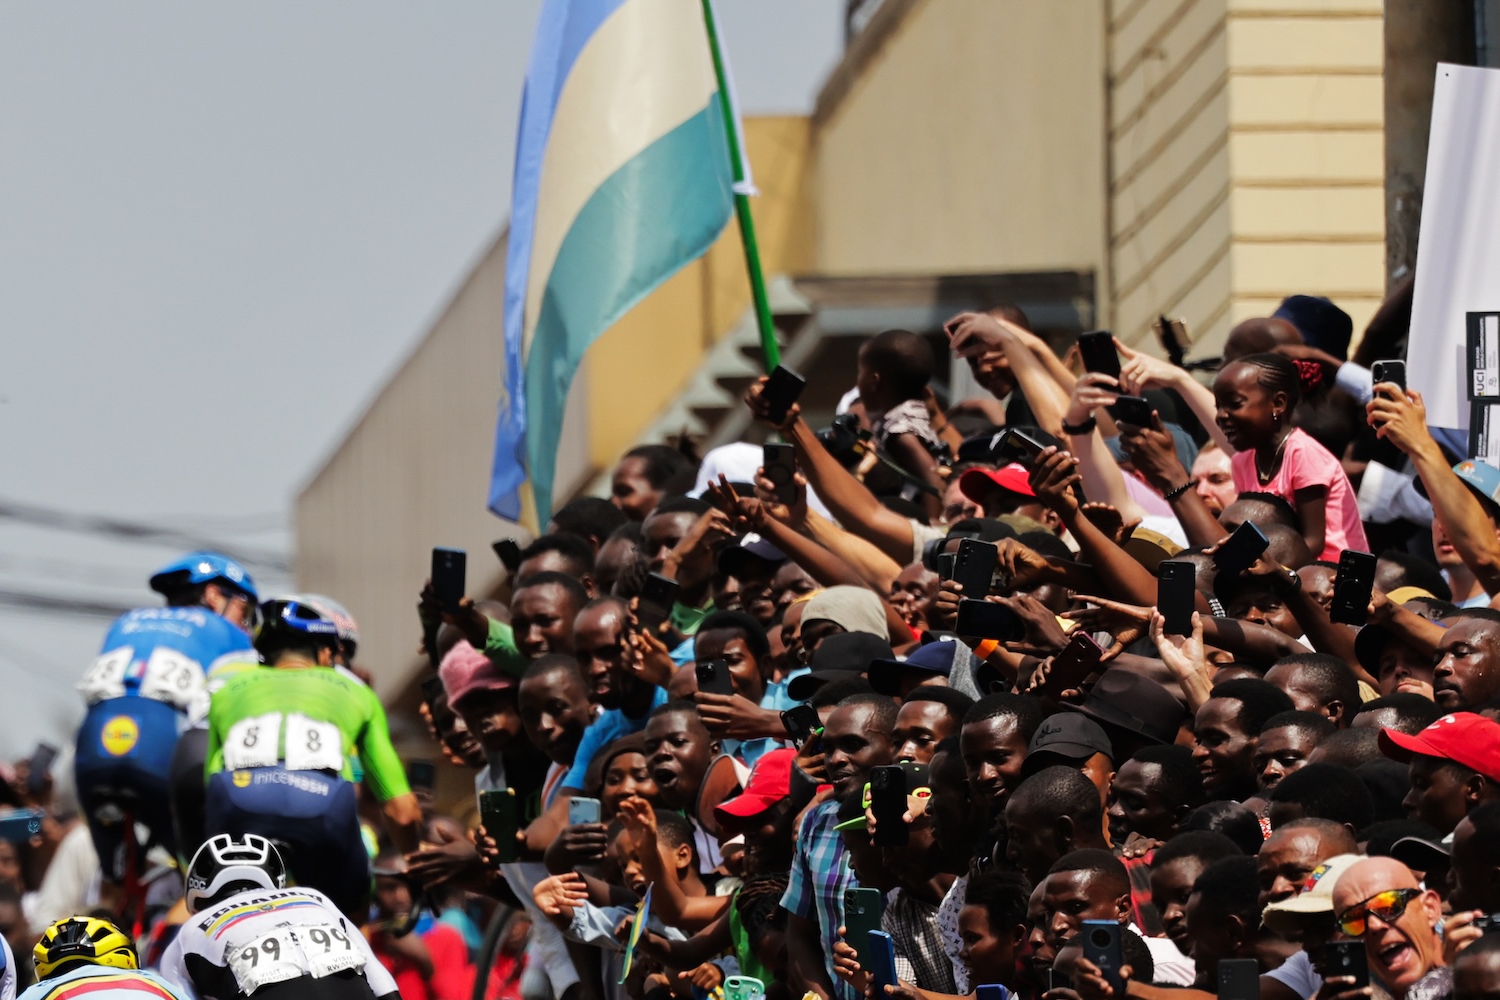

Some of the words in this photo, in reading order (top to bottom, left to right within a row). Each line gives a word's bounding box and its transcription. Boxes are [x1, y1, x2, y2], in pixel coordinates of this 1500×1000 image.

[160, 661, 192, 690] 28
[306, 729, 322, 752] 8
[198, 891, 324, 933] ECUADOR
[241, 937, 280, 968] 99
[309, 928, 351, 953] 99
